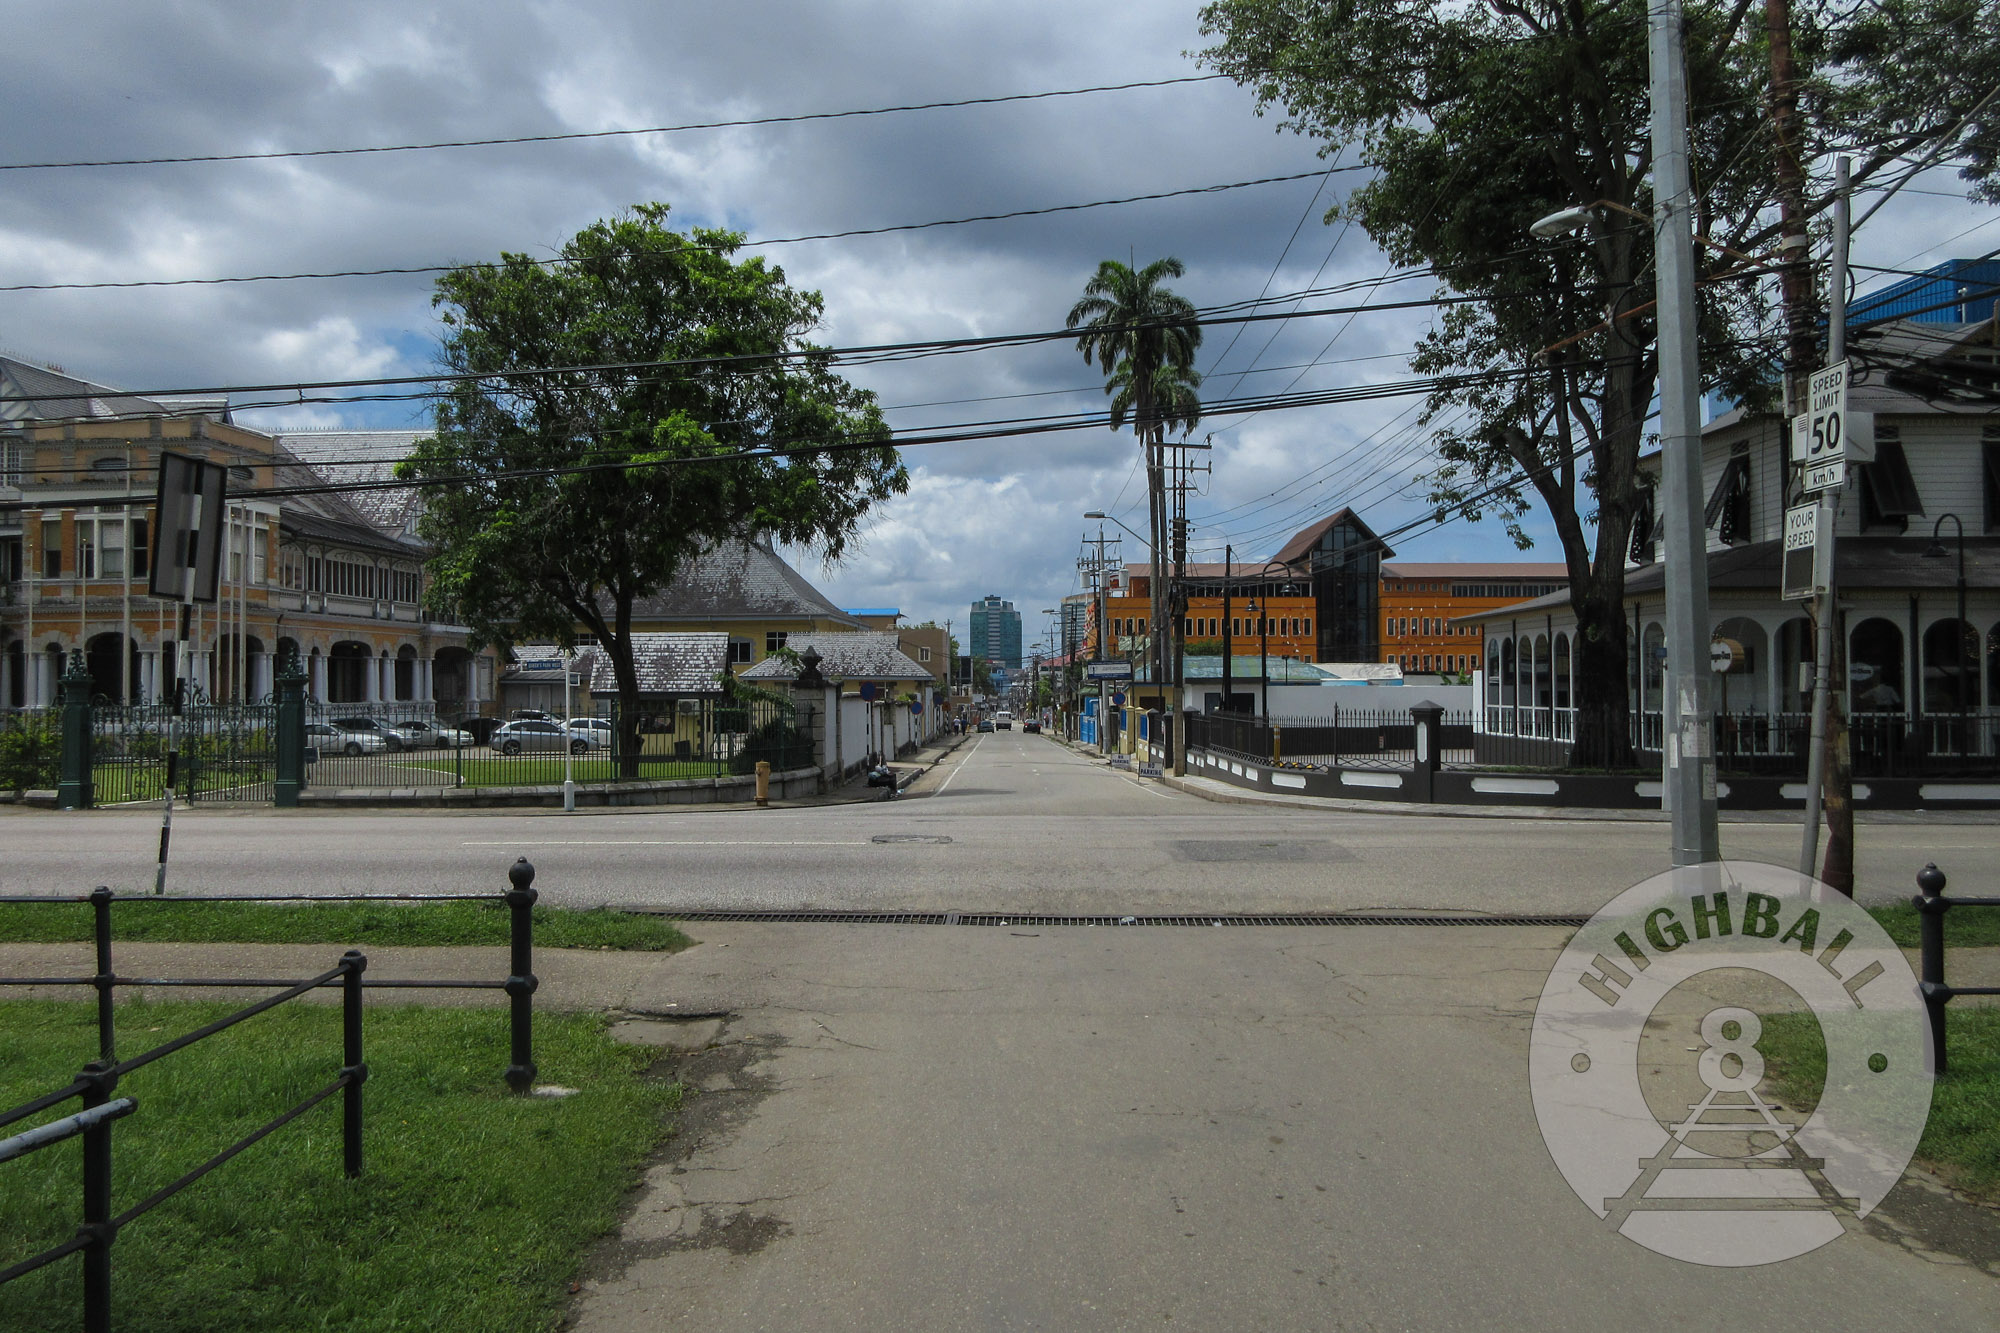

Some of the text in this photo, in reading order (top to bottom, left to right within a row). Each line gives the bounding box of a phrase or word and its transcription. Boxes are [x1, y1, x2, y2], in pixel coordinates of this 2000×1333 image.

[1812, 371, 1842, 395] SPEED
[1814, 390, 1839, 412] LIMIT
[1811, 411, 1840, 455] 50
[1812, 467, 1835, 486] km/h
[1789, 510, 1814, 530] YOUR
[1786, 529, 1815, 549] SPEED
[1140, 768, 1162, 776] PARKING
